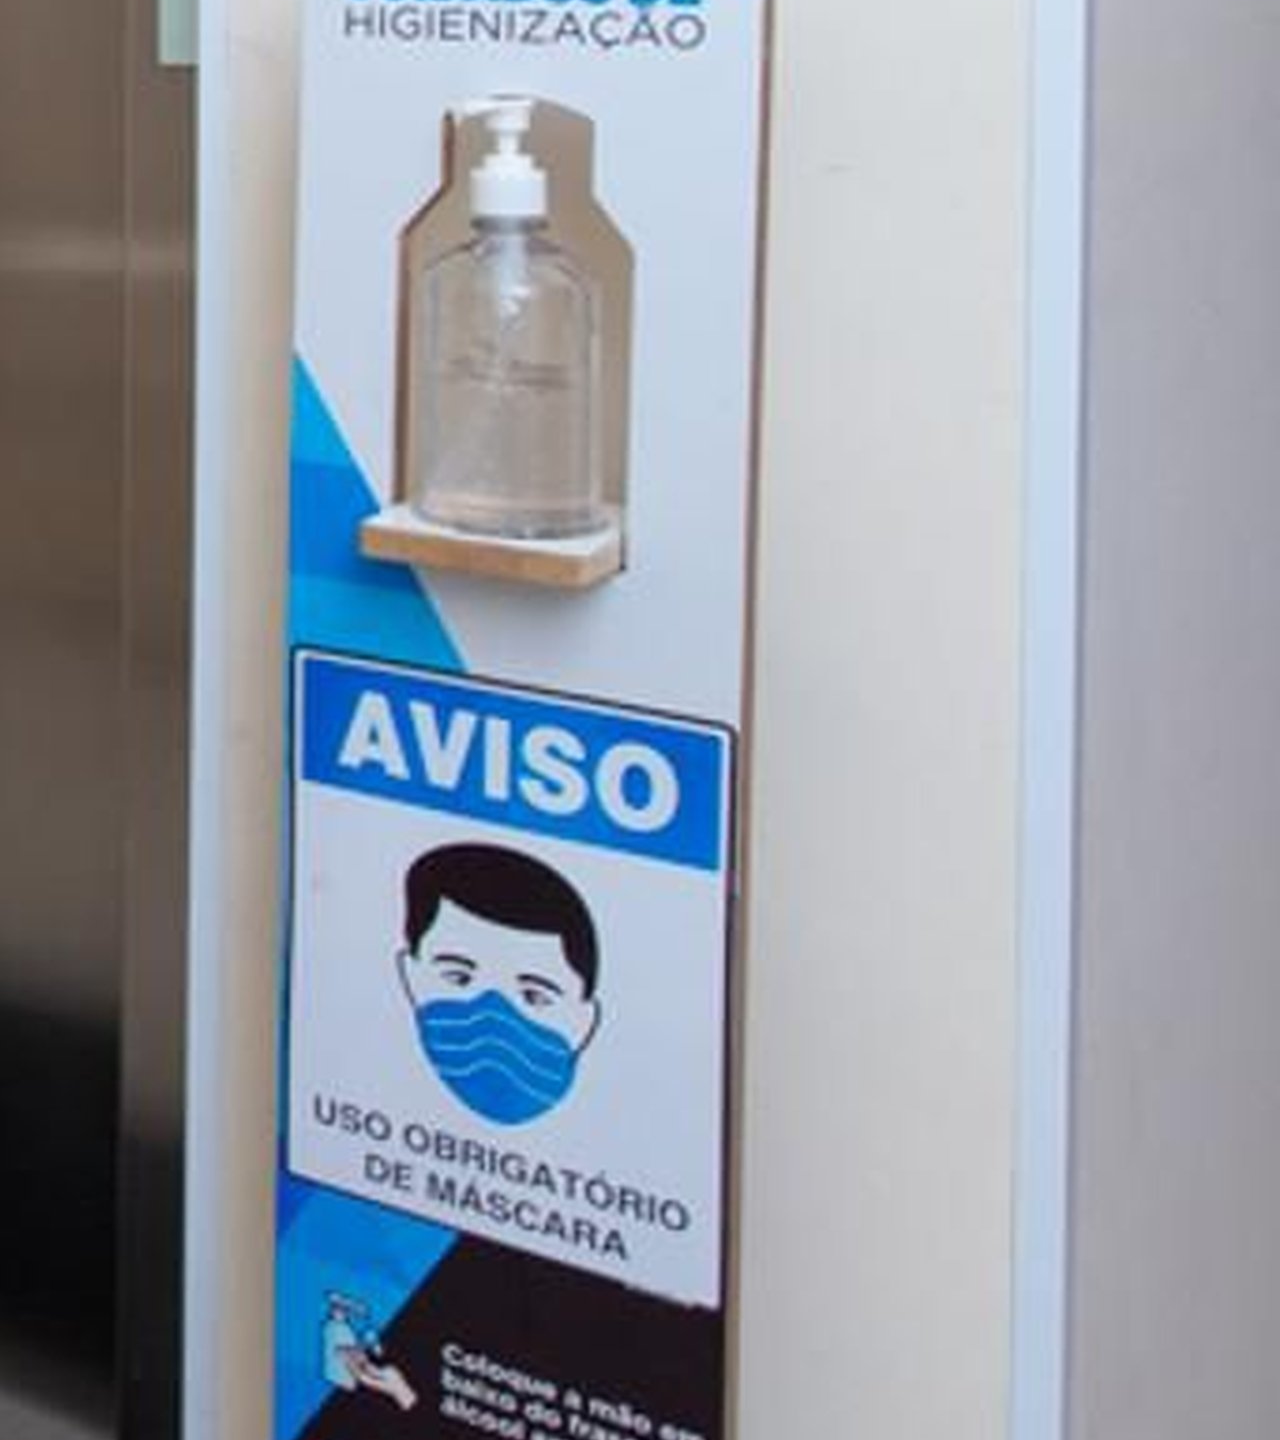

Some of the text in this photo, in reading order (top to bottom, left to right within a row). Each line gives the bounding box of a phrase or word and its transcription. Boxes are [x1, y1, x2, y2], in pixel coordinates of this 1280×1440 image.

[338, 691, 679, 832] AVISO
[313, 1094, 692, 1232] USO OBRIGATÓRIO
[364, 1153, 629, 1260] DE MÁSCARA
[524, 1400, 561, 1428] do
